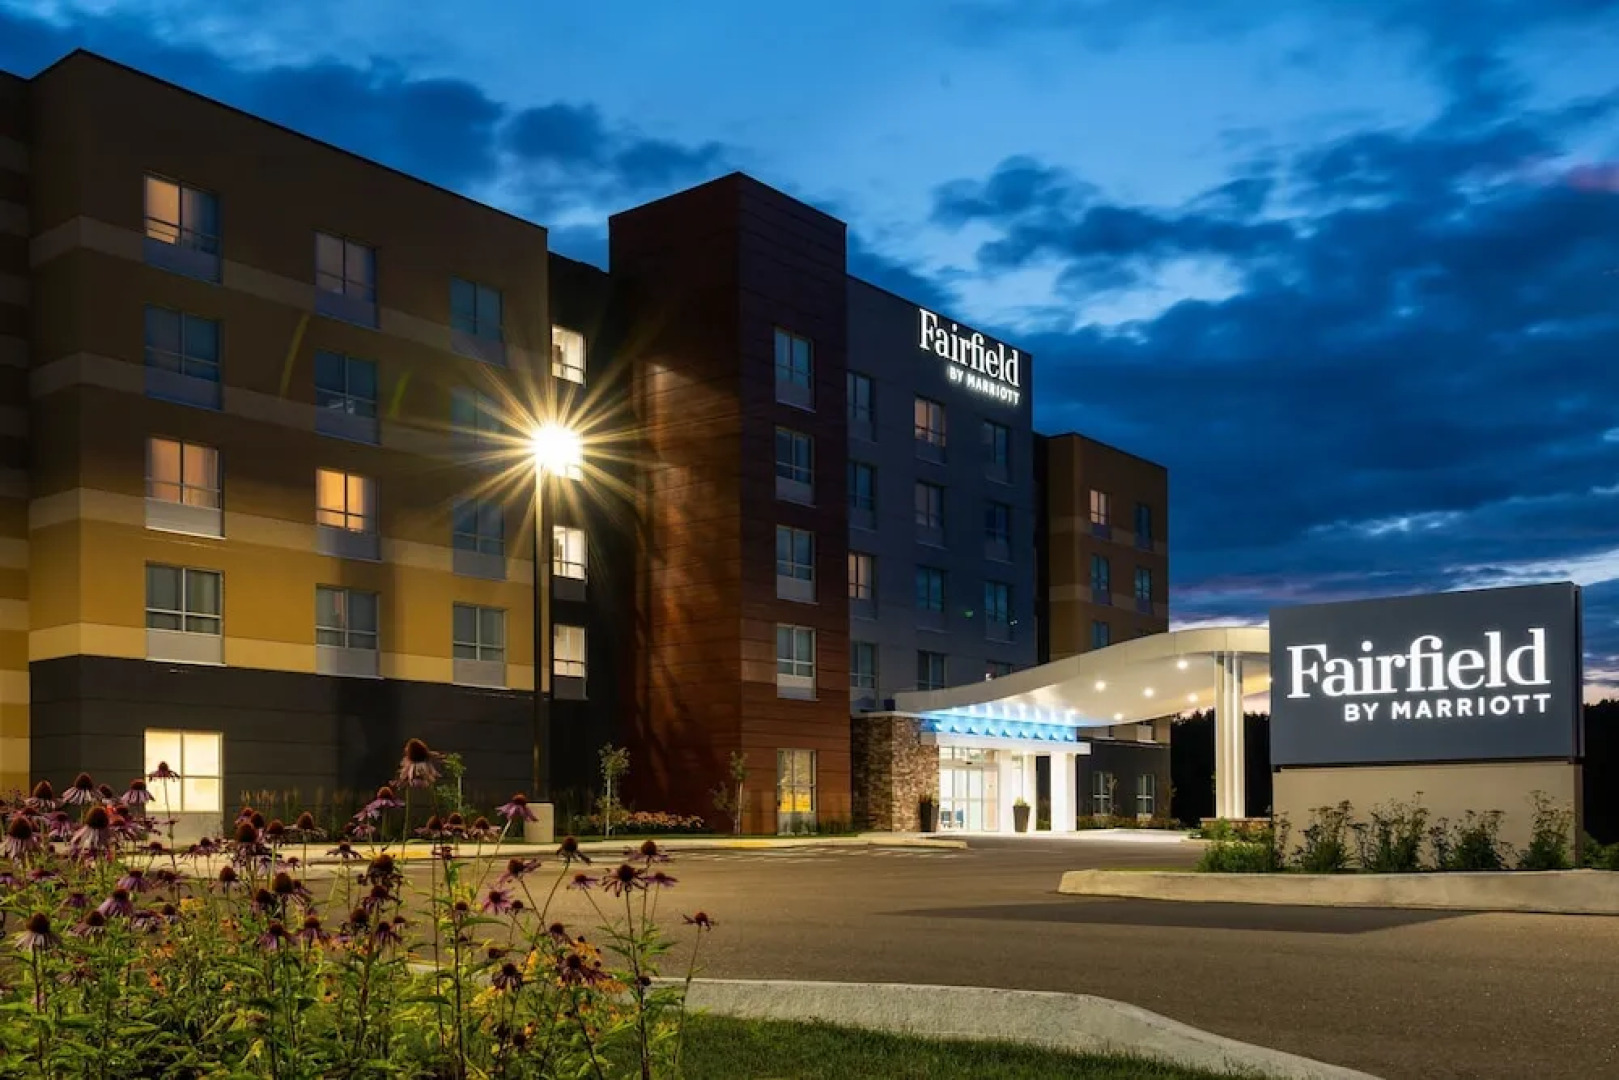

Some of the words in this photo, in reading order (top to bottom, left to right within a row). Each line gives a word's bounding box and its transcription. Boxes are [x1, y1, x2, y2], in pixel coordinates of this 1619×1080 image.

[919, 308, 1020, 387] Fairfield
[949, 365, 964, 382] BY
[966, 373, 1020, 405] MARRIOTT
[1286, 627, 1551, 699] Fairfield
[1344, 702, 1379, 722] BY
[1391, 693, 1552, 720] MARRIOTT
